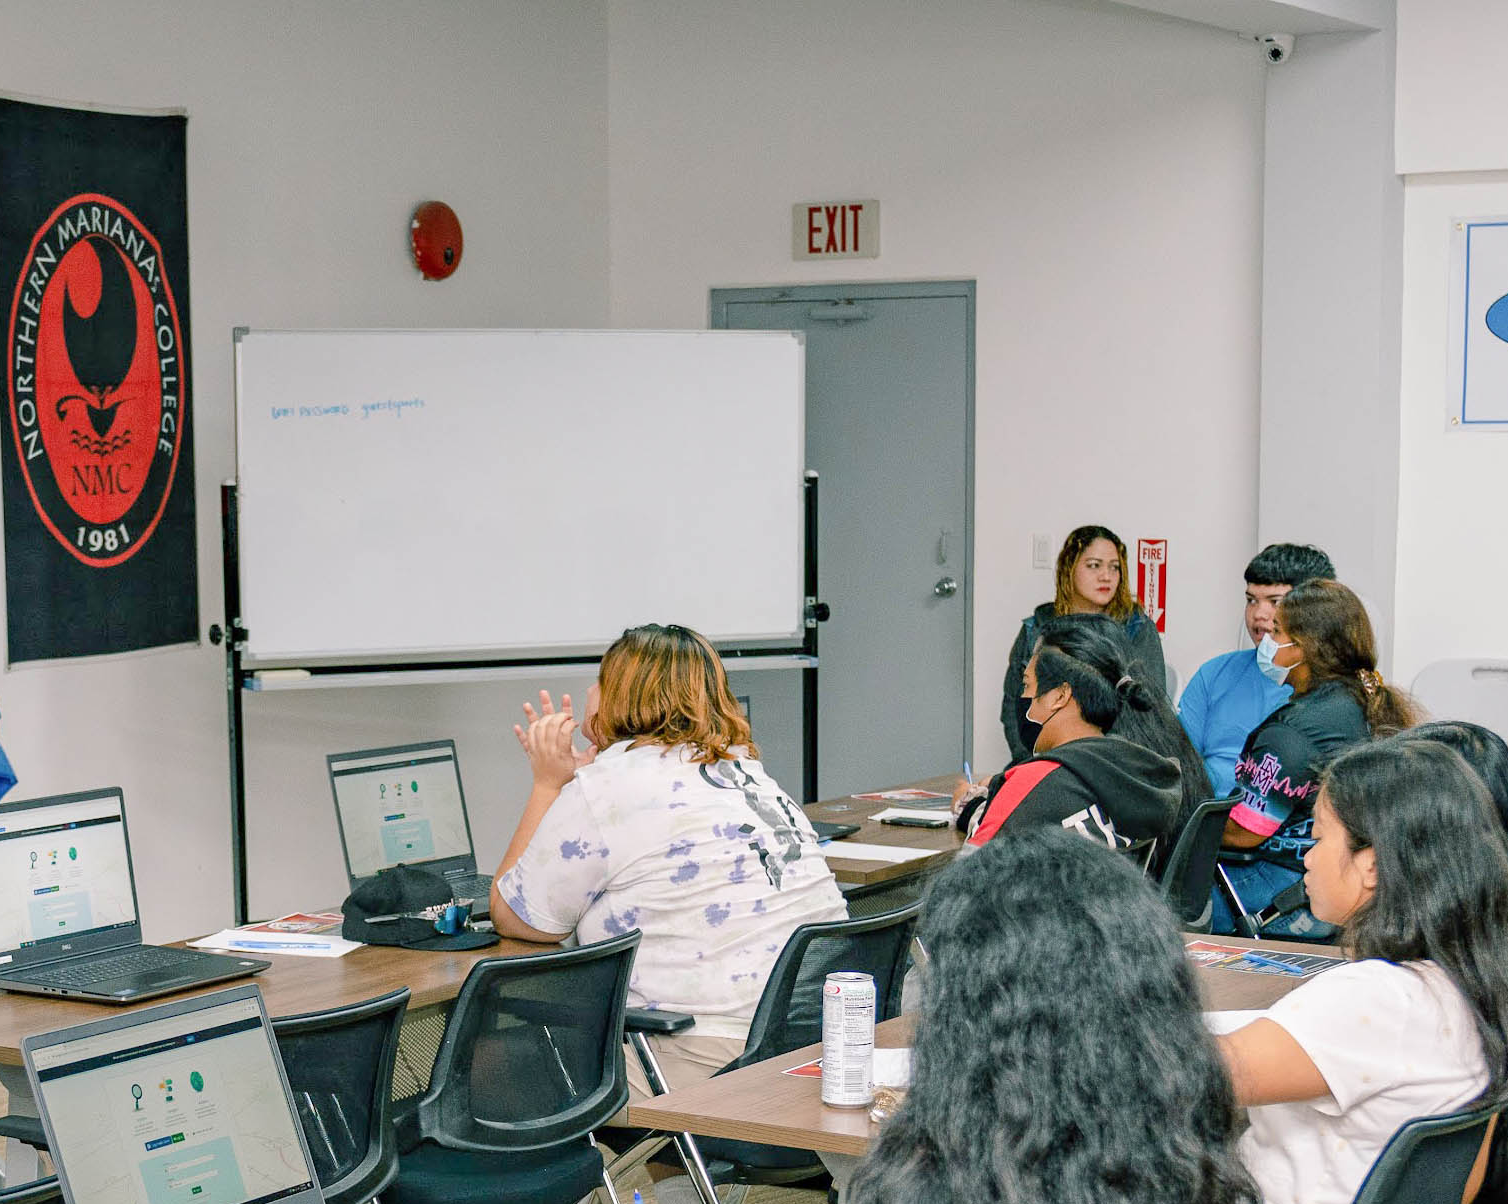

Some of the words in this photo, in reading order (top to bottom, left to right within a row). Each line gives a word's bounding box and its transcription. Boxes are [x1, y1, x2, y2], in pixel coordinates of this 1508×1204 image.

[807, 204, 863, 254] EXIT
[17, 242, 57, 460] NORTHERN
[57, 205, 160, 294] MARIANAS
[153, 303, 177, 457] COLLEGE
[71, 463, 133, 497] NMC
[76, 523, 131, 552] 1981
[1142, 547, 1163, 560] FIRE
